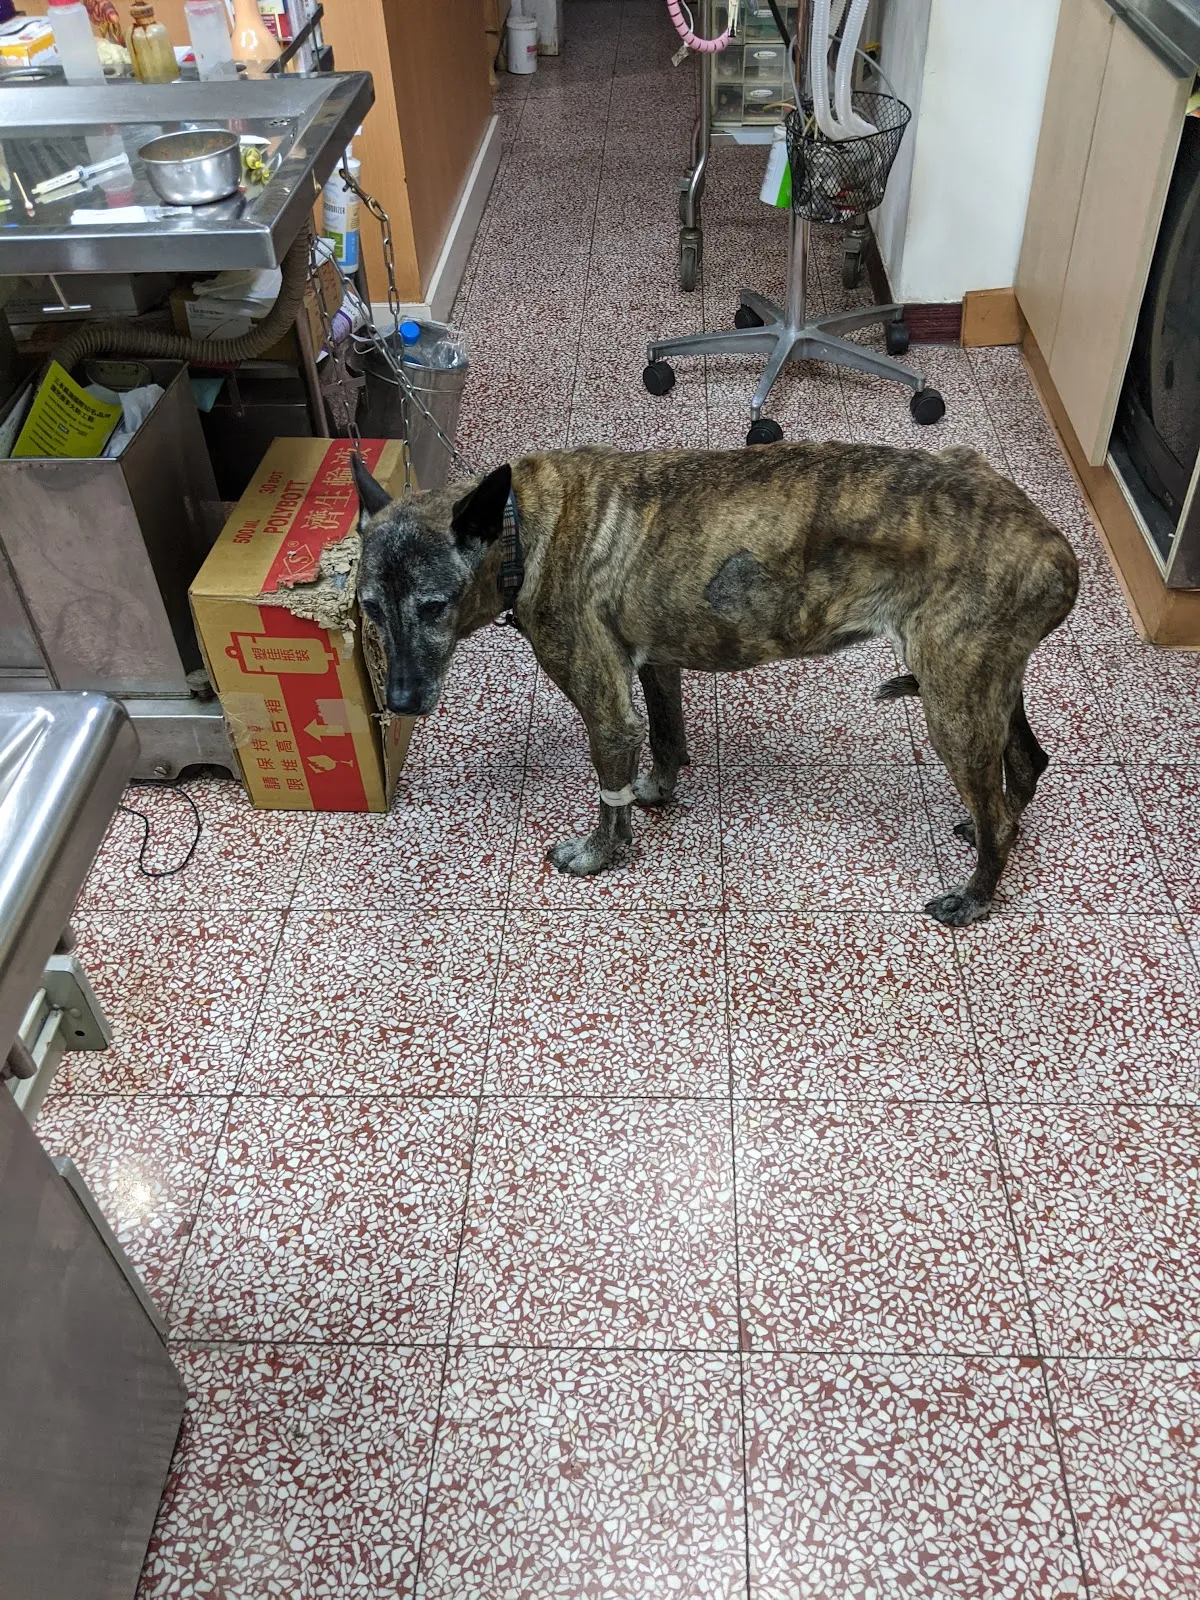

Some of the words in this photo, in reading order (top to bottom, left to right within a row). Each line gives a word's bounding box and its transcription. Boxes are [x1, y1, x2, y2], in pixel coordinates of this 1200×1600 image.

[263, 480, 308, 534] POLYBOTT
[263, 699, 305, 791] 限堆高5箱
